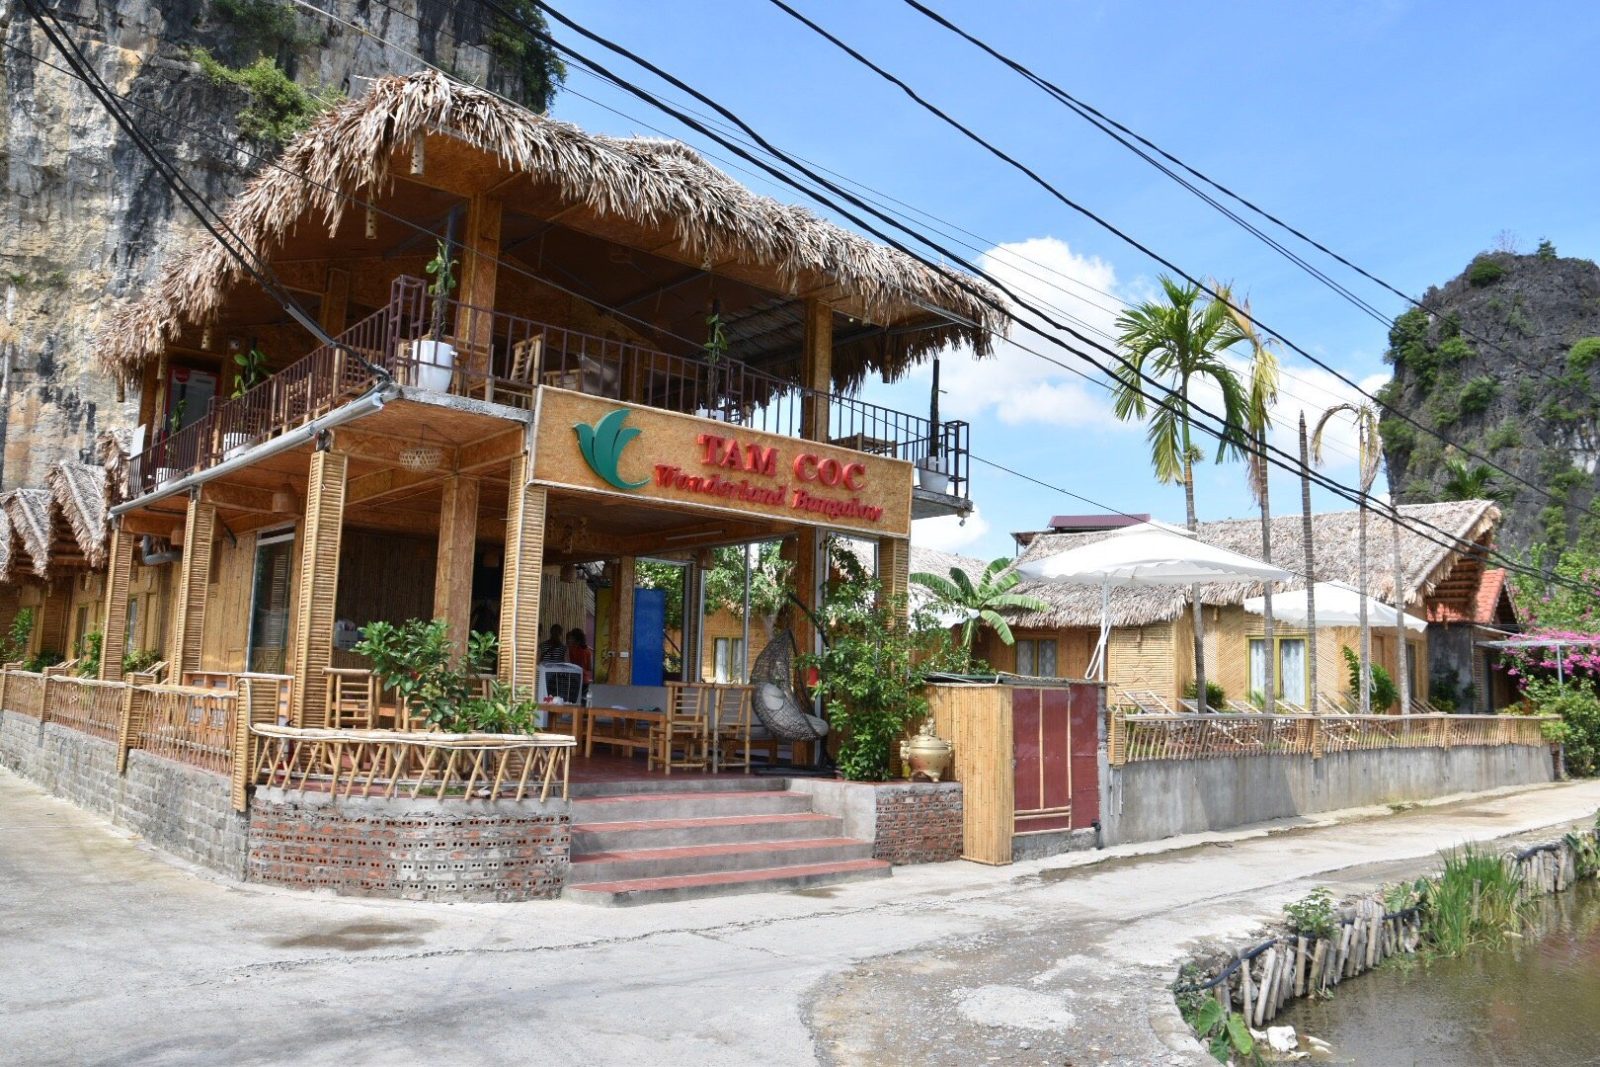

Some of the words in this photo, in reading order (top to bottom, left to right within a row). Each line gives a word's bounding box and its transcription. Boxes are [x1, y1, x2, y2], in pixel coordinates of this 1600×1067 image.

[654, 463, 787, 506] Wonderland
[697, 435, 779, 477] TAM
[792, 453, 866, 491] COC
